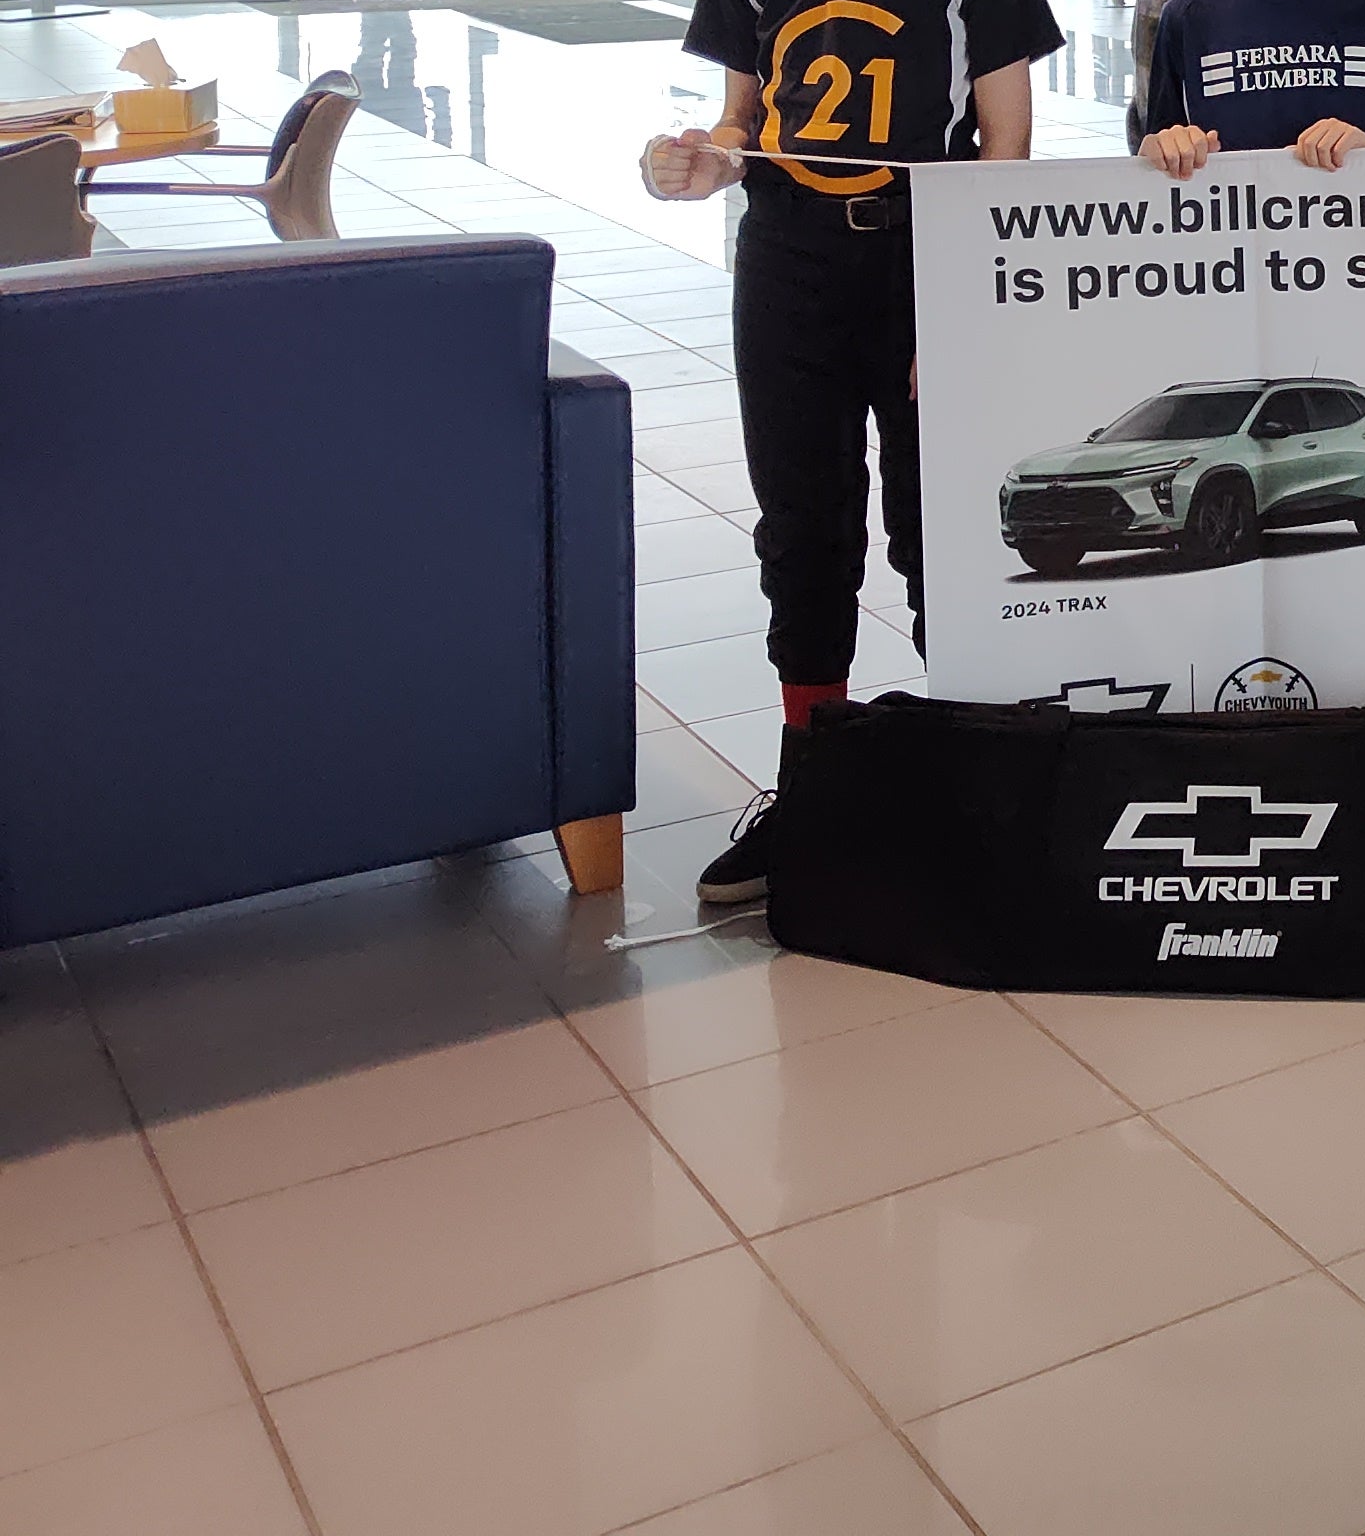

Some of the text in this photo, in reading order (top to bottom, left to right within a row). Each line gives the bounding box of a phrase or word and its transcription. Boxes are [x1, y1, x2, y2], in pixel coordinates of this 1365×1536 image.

[1235, 44, 1342, 69] FERRARA
[1240, 68, 1338, 92] LUMBER
[794, 54, 895, 144] 21
[994, 256, 1045, 304] is
[1067, 247, 1246, 310] proud
[1265, 249, 1326, 292] to
[1002, 595, 1107, 619] 2024 TRAX
[1225, 695, 1307, 712] CHEVY YOUTH
[1098, 876, 1340, 902] CHEVROLET
